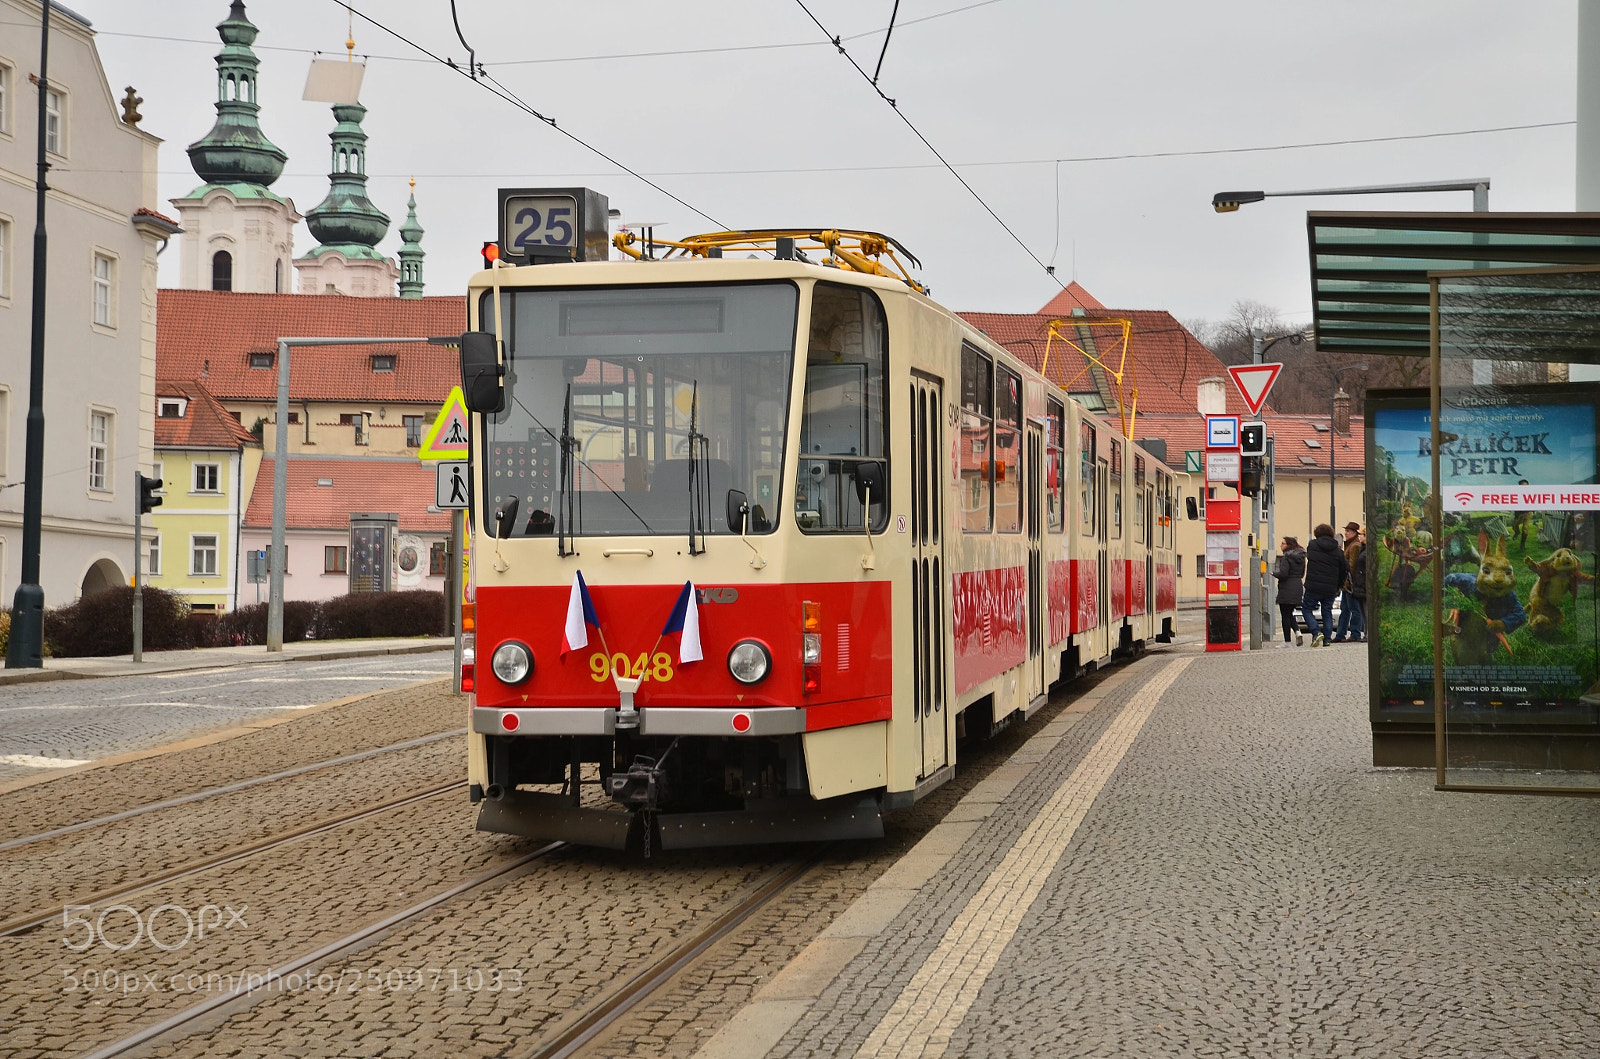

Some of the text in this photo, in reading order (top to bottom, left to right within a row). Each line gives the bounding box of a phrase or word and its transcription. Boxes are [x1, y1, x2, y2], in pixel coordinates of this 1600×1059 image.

[514, 207, 573, 247] 25
[1450, 457, 1522, 477] PETR
[1481, 493, 1600, 505] FREE WIFI HERE
[589, 652, 674, 682] 9048
